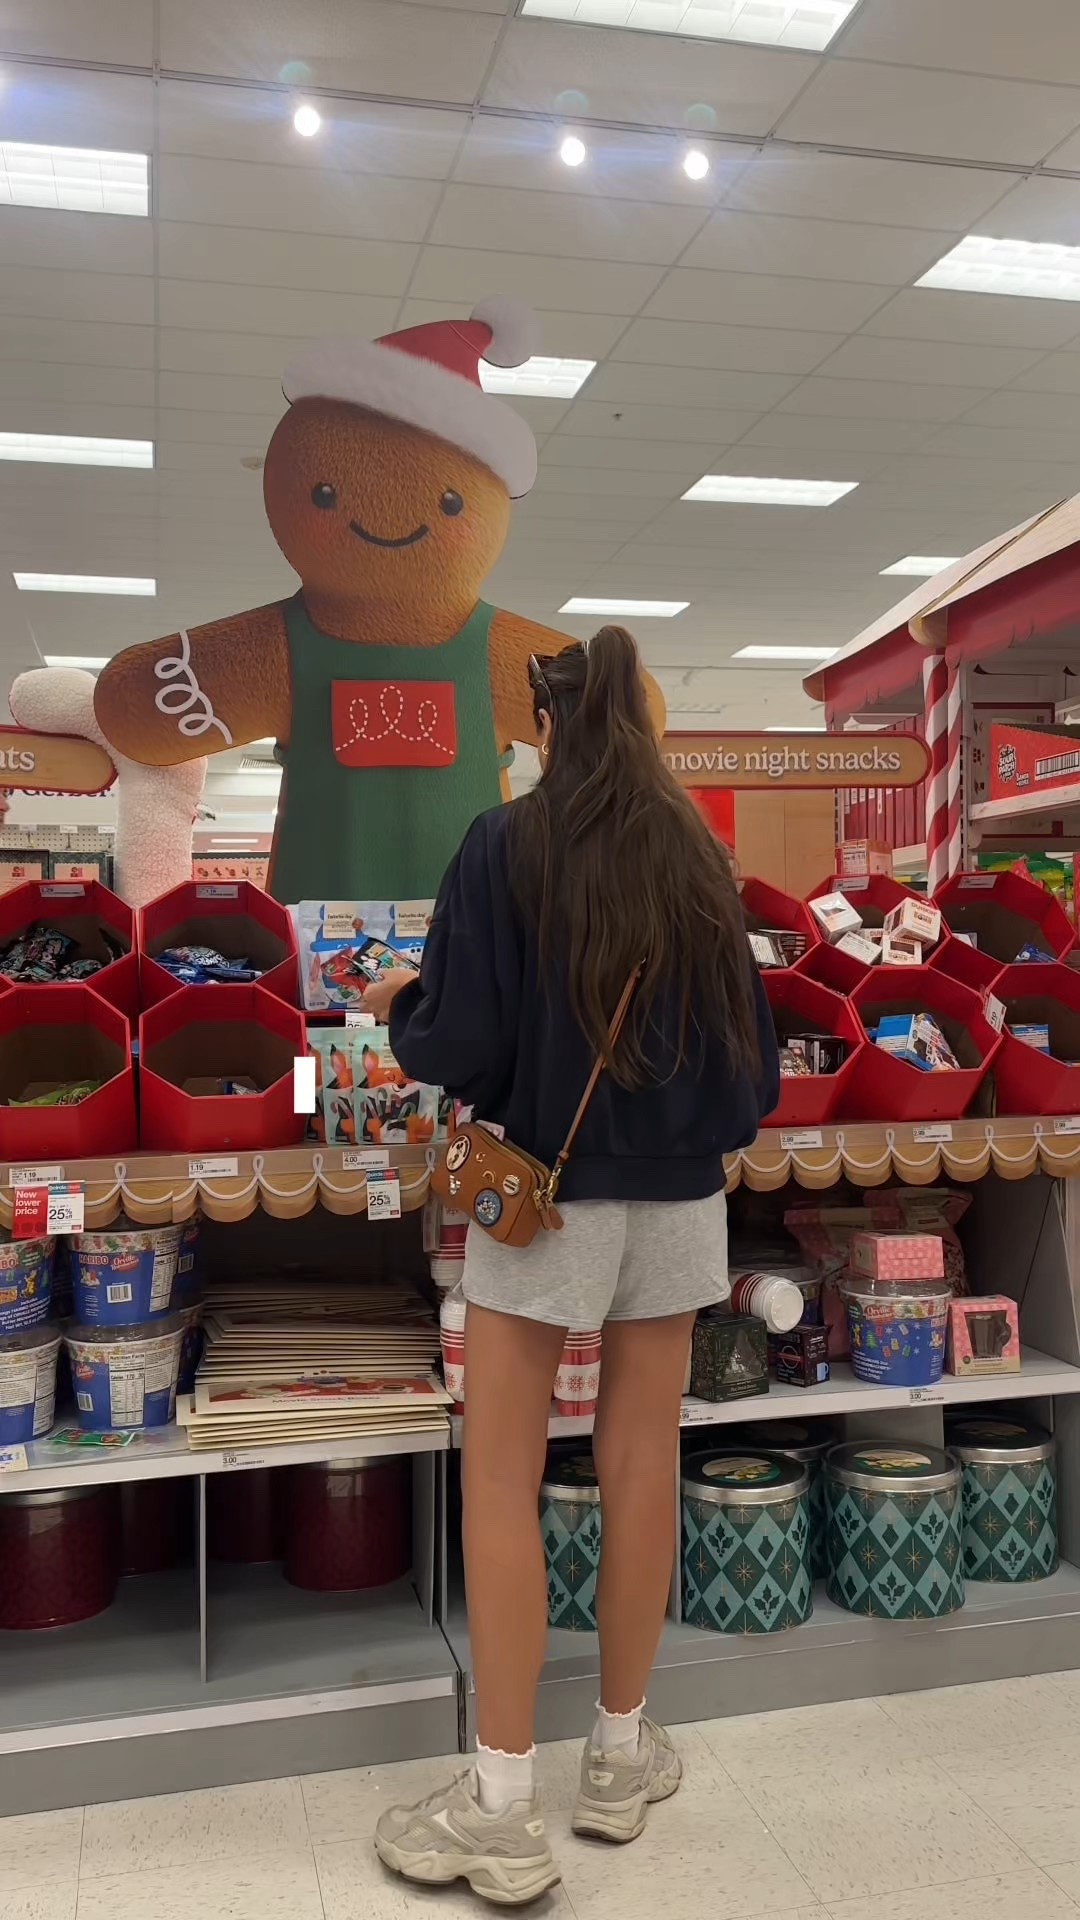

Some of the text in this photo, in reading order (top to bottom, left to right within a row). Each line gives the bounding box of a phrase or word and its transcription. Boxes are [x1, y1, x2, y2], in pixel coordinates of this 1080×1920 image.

[664, 746, 901, 777] movie night snacks
[998, 762, 1015, 774] PATCH
[16, 1199, 41, 1207] lower
[15, 1207, 38, 1216] price
[79, 1254, 109, 1265] HARIBO
